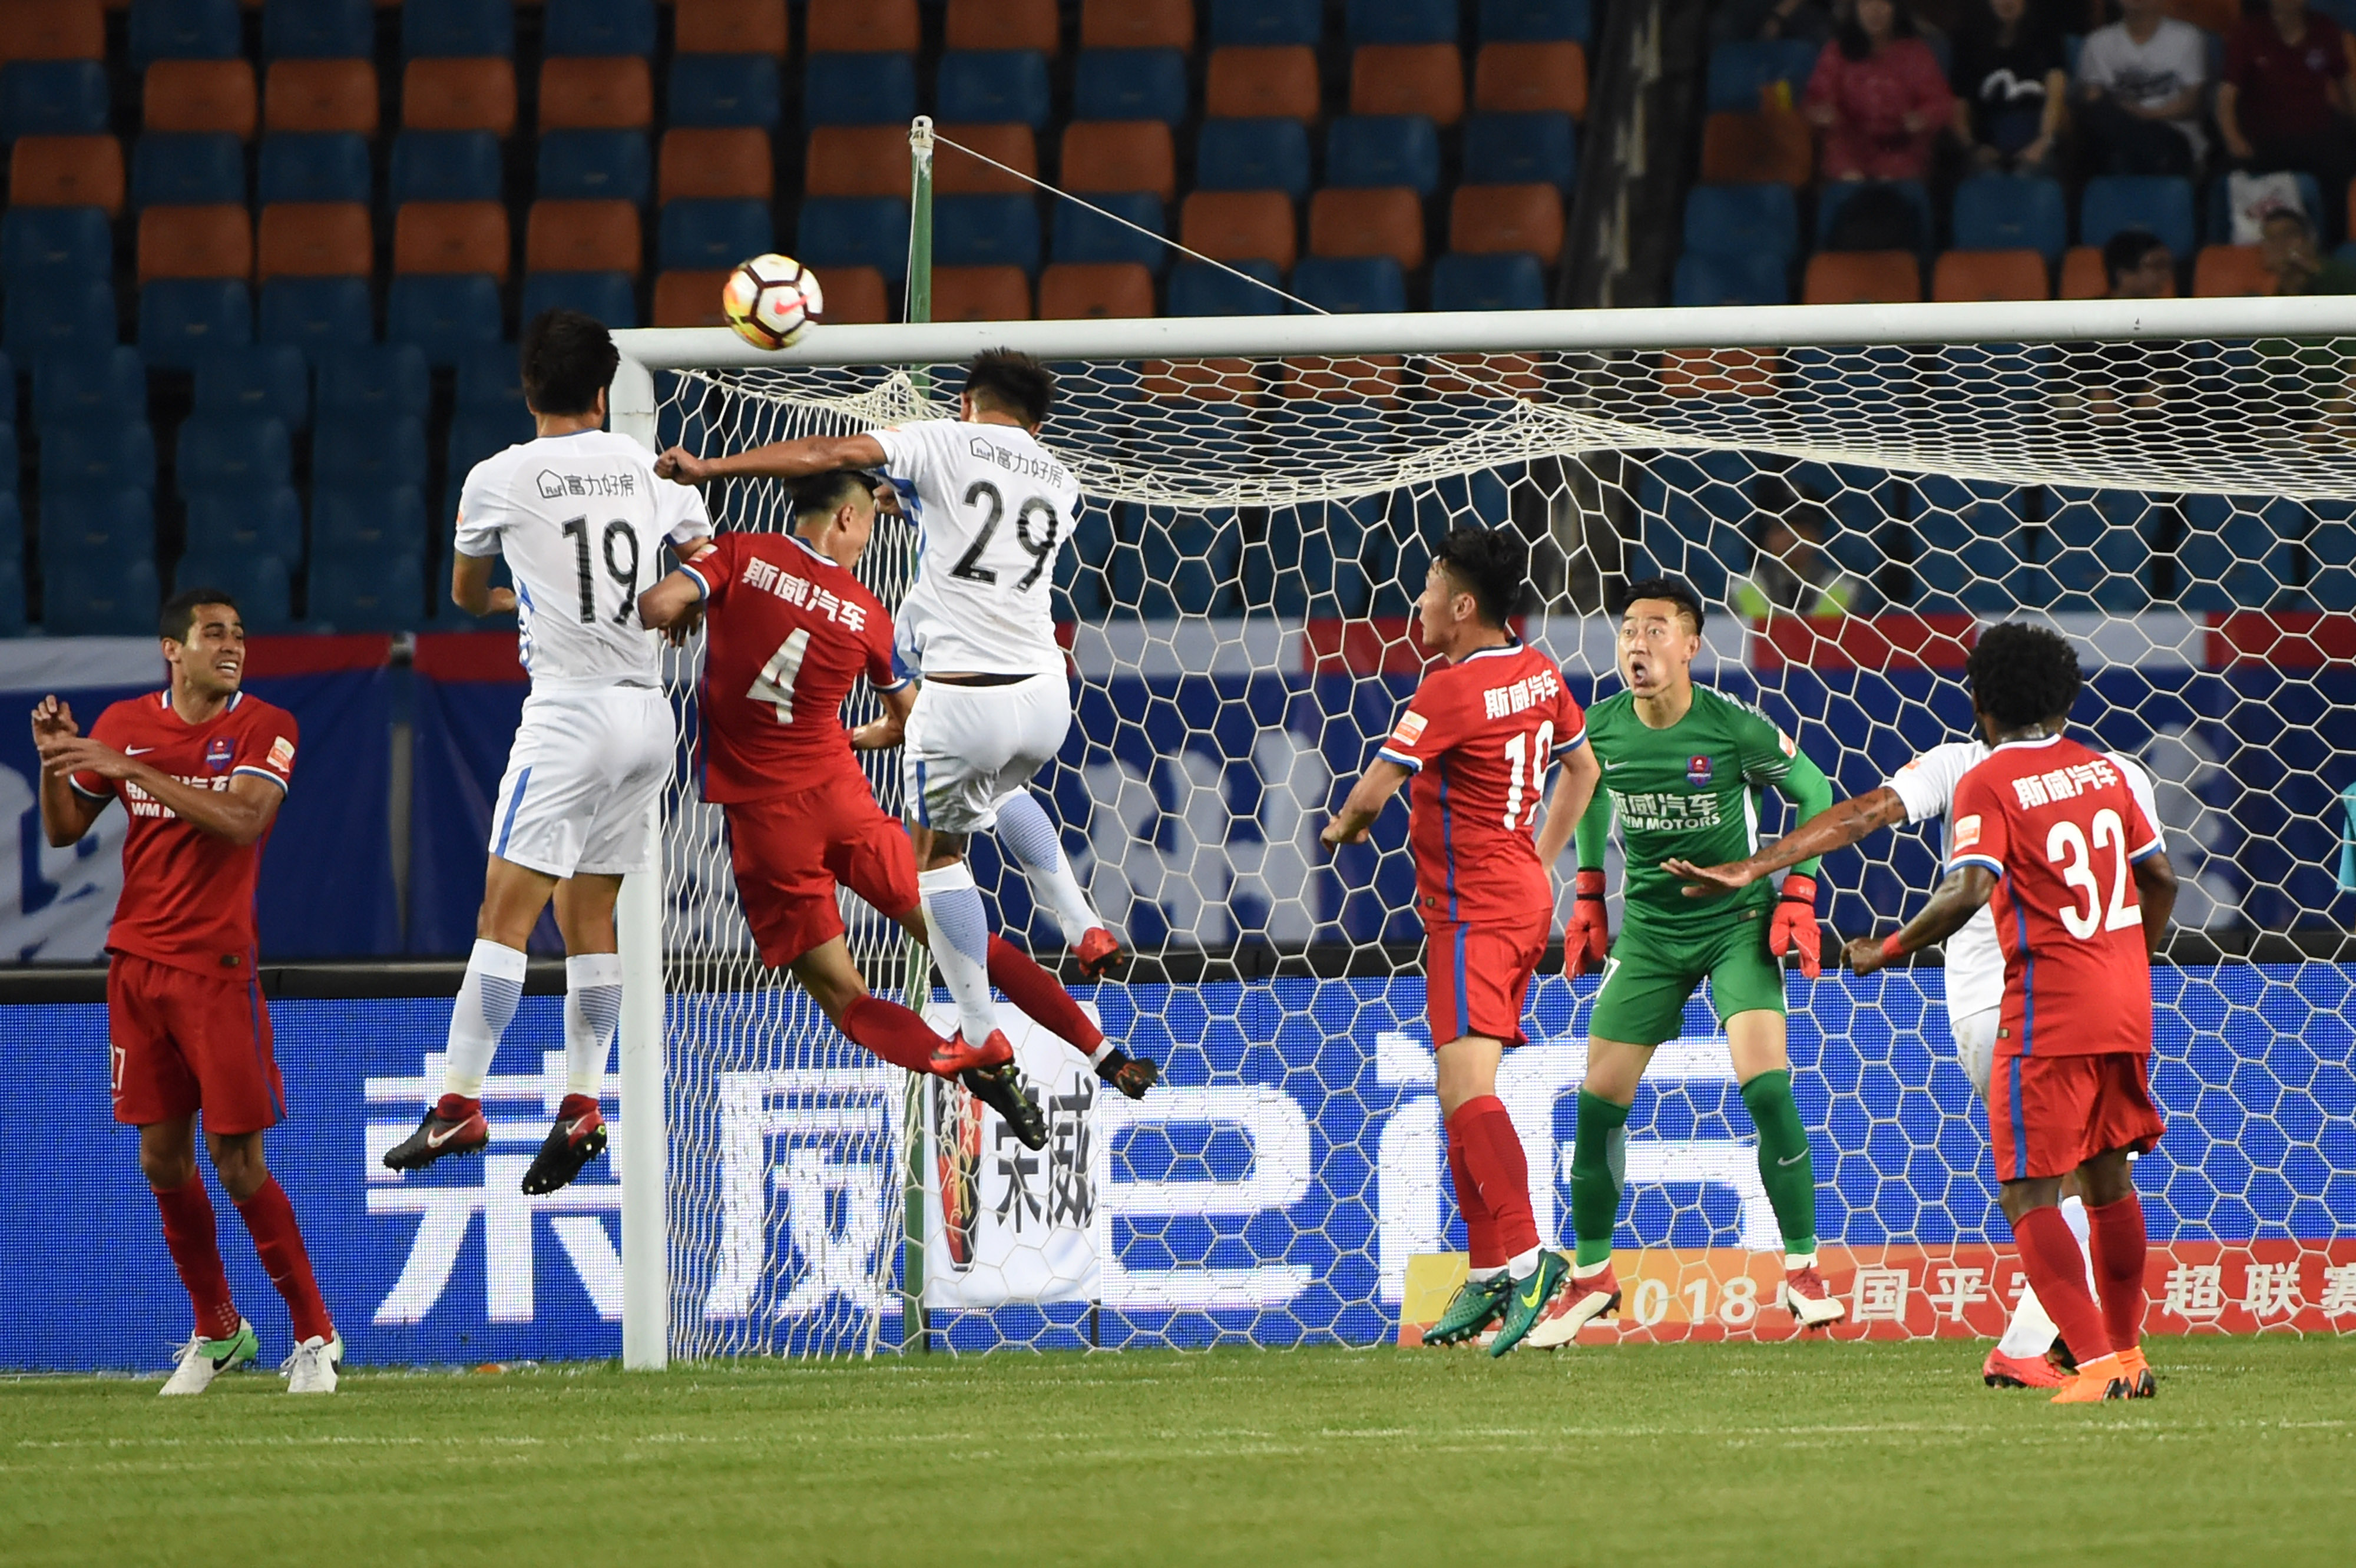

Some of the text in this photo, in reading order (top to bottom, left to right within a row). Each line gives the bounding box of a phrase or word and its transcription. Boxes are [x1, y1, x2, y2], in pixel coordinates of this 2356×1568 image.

[564, 474, 634, 497] 富力好房
[995, 446, 1064, 489] 富力好房
[948, 480, 1058, 594] 29
[561, 514, 640, 625] 19
[740, 557, 868, 633] 斯威汽车
[746, 627, 810, 725] 4
[1483, 669, 1560, 720] 斯威汽车
[131, 802, 160, 817] WM
[2011, 759, 2118, 811] 斯威汽车
[1646, 812, 1721, 830] MOTORS
[2046, 808, 2143, 941] 32
